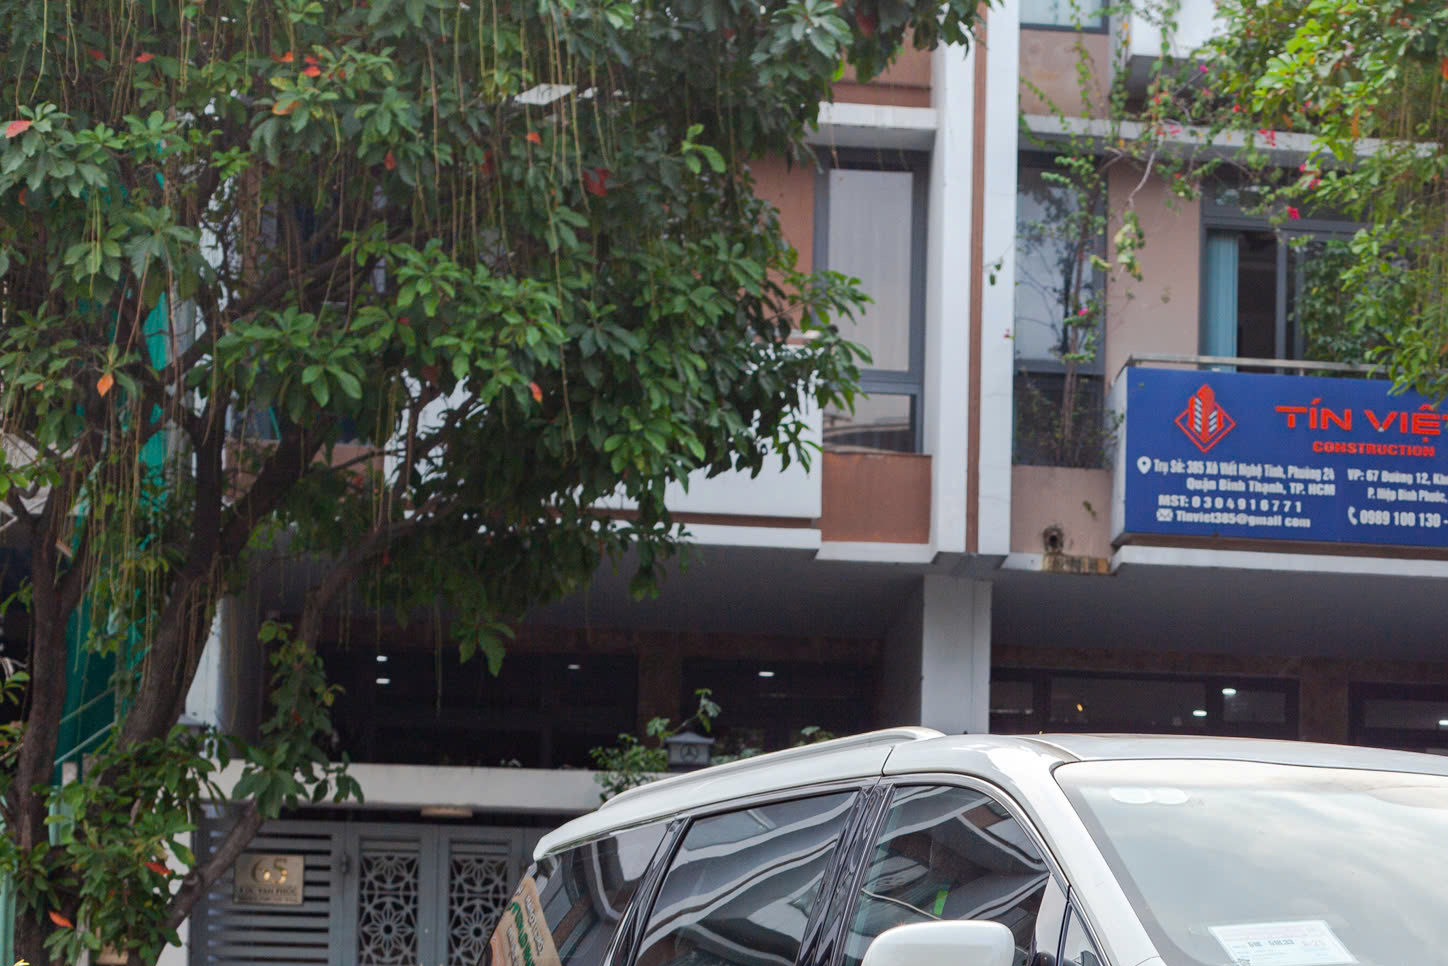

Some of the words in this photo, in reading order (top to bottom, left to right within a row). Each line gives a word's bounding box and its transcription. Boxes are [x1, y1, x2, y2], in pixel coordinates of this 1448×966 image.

[1275, 397, 1352, 431] TÍN
[1313, 441, 1436, 458] CONSTRUCTION
[1186, 477, 1216, 492] Quận
[1290, 482, 1306, 495] TP.
[1308, 483, 1336, 496] HCM
[1158, 494, 1189, 507] MST:
